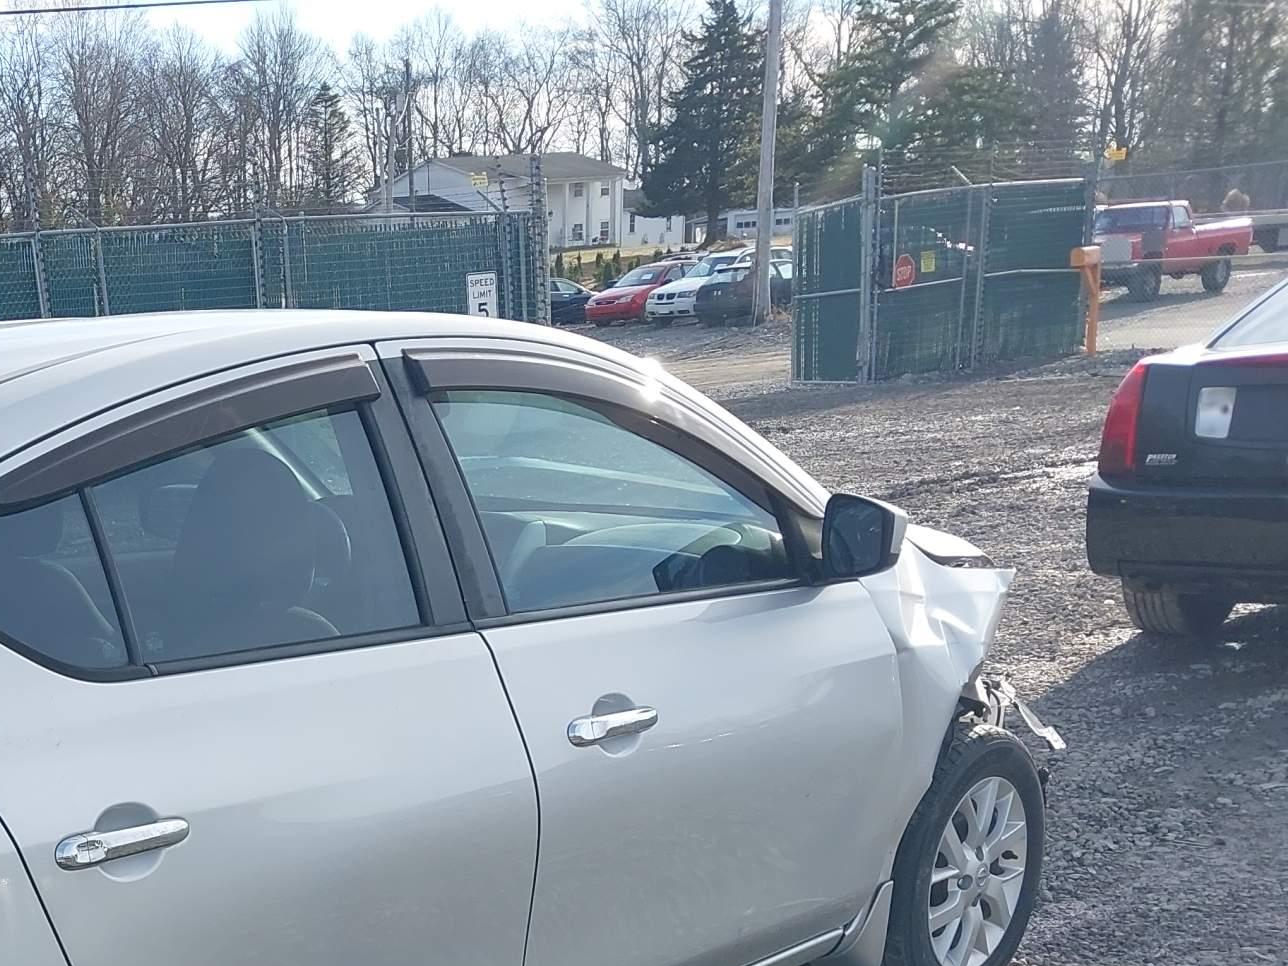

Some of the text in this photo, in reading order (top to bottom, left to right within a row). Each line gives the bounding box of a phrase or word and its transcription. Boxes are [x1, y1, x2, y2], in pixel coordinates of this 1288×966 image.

[896, 265, 912, 281] STOP
[469, 278, 495, 288] SPEED
[472, 289, 492, 299] LIMIT
[477, 302, 489, 317] 5
